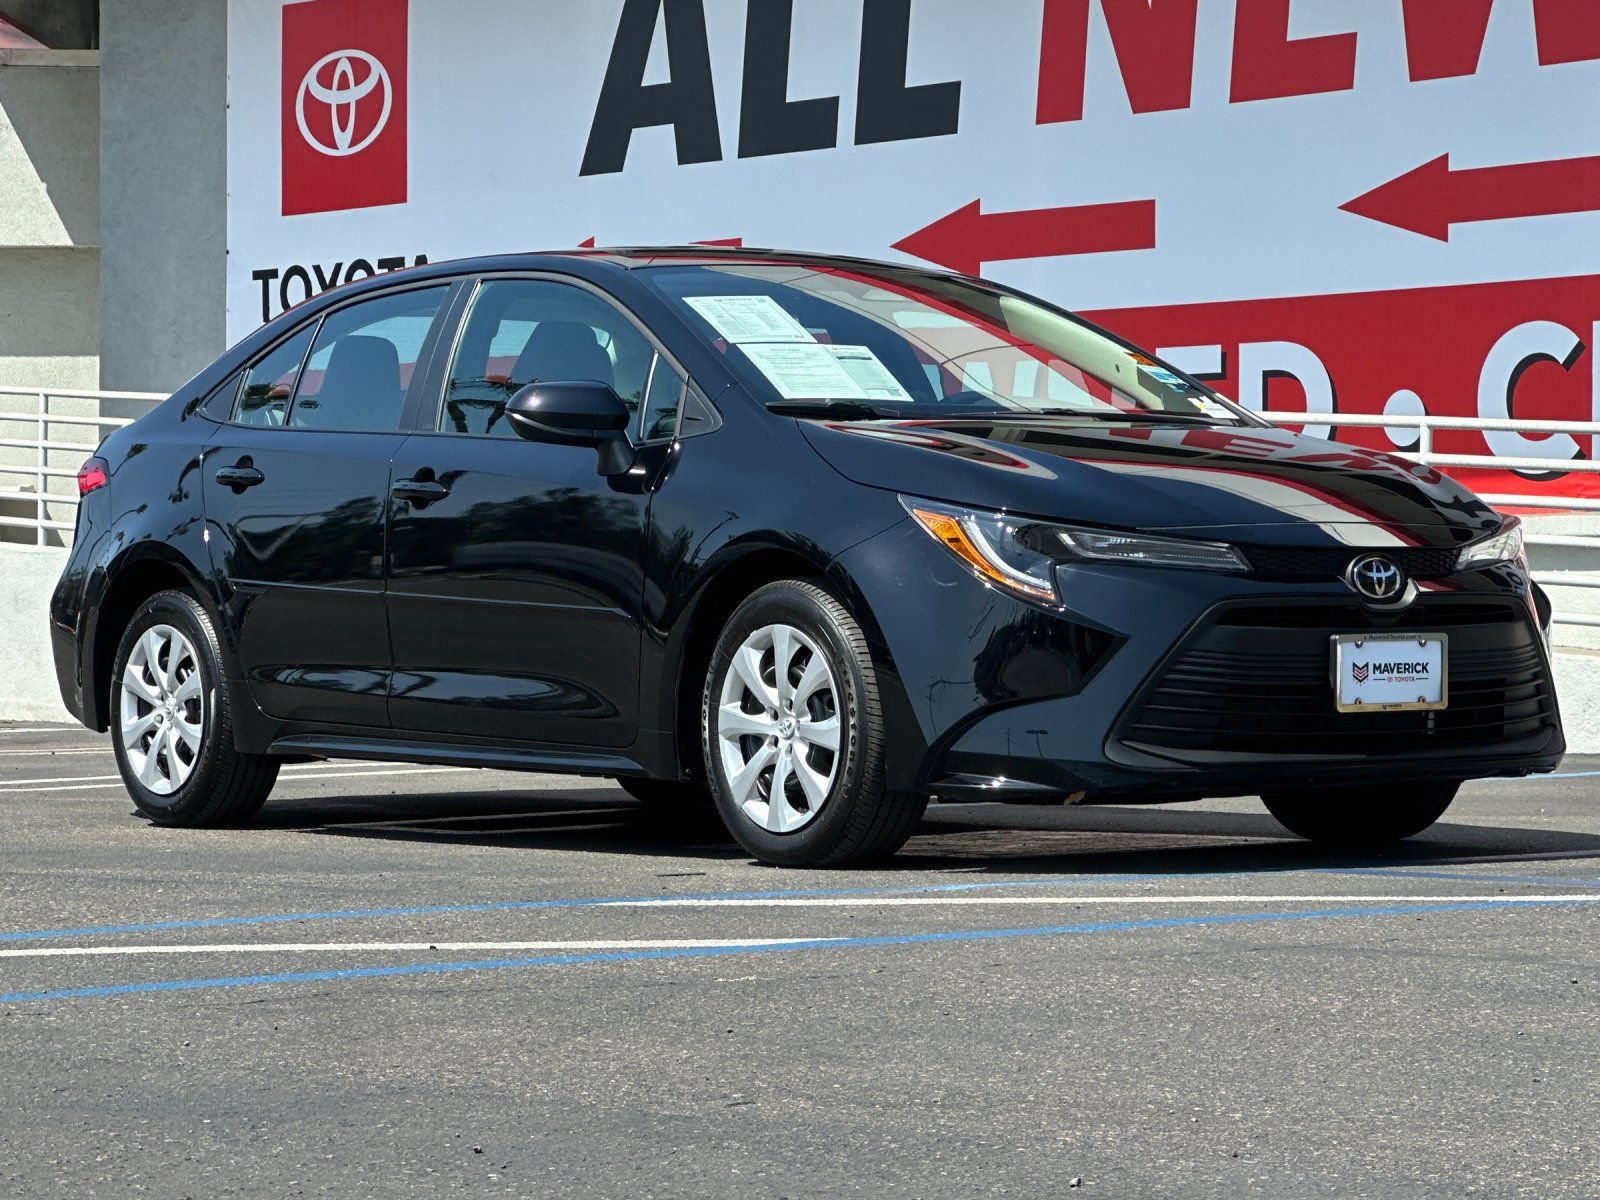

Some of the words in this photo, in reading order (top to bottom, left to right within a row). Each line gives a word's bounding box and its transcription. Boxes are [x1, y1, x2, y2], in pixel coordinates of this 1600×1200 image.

[578, 0, 962, 177] ALL
[252, 254, 428, 323] TOY
[1477, 320, 1600, 481] C
[1373, 662, 1429, 674] MAVERICK
